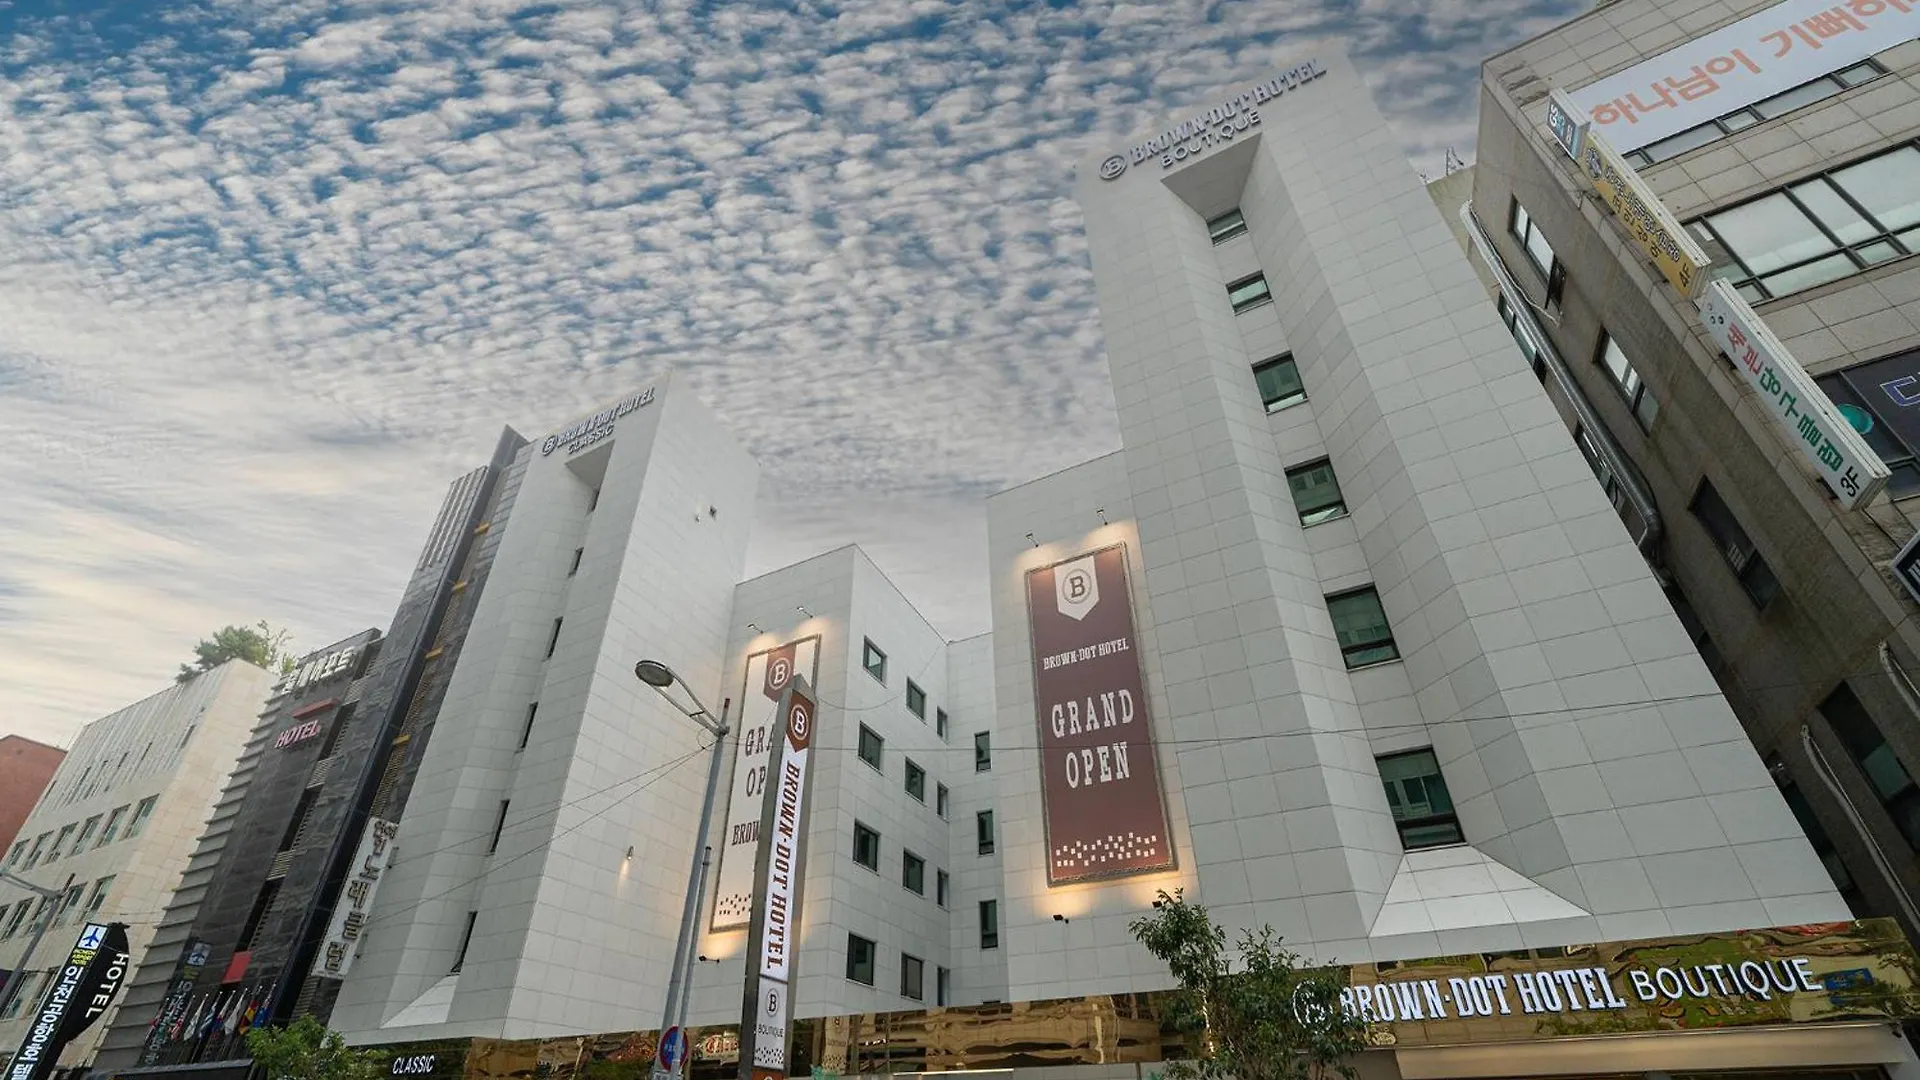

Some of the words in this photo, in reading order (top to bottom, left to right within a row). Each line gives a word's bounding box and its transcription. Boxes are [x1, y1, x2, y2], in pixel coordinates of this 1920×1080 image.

[1252, 60, 1327, 105] HOTEL
[1588, 48, 1762, 126] 하나님이
[1160, 108, 1261, 169] BOUTIQUE
[1678, 263, 1691, 288] 4F
[568, 424, 614, 454] CLASSIC
[1840, 465, 1860, 498] 3F
[1098, 638, 1130, 657] HOTEL
[274, 720, 318, 748] HOTEL
[1052, 689, 1134, 738] GRAND
[1066, 742, 1131, 789] OPEN
[767, 893, 787, 969] HOTEL
[85, 953, 129, 1018] HOTEL
[1513, 968, 1626, 1014] HOTEL
[1630, 958, 1823, 1000] BOUTIQUE
[757, 1022, 784, 1038] BOUTIQUE
[392, 1055, 435, 1075] CLASSIC
